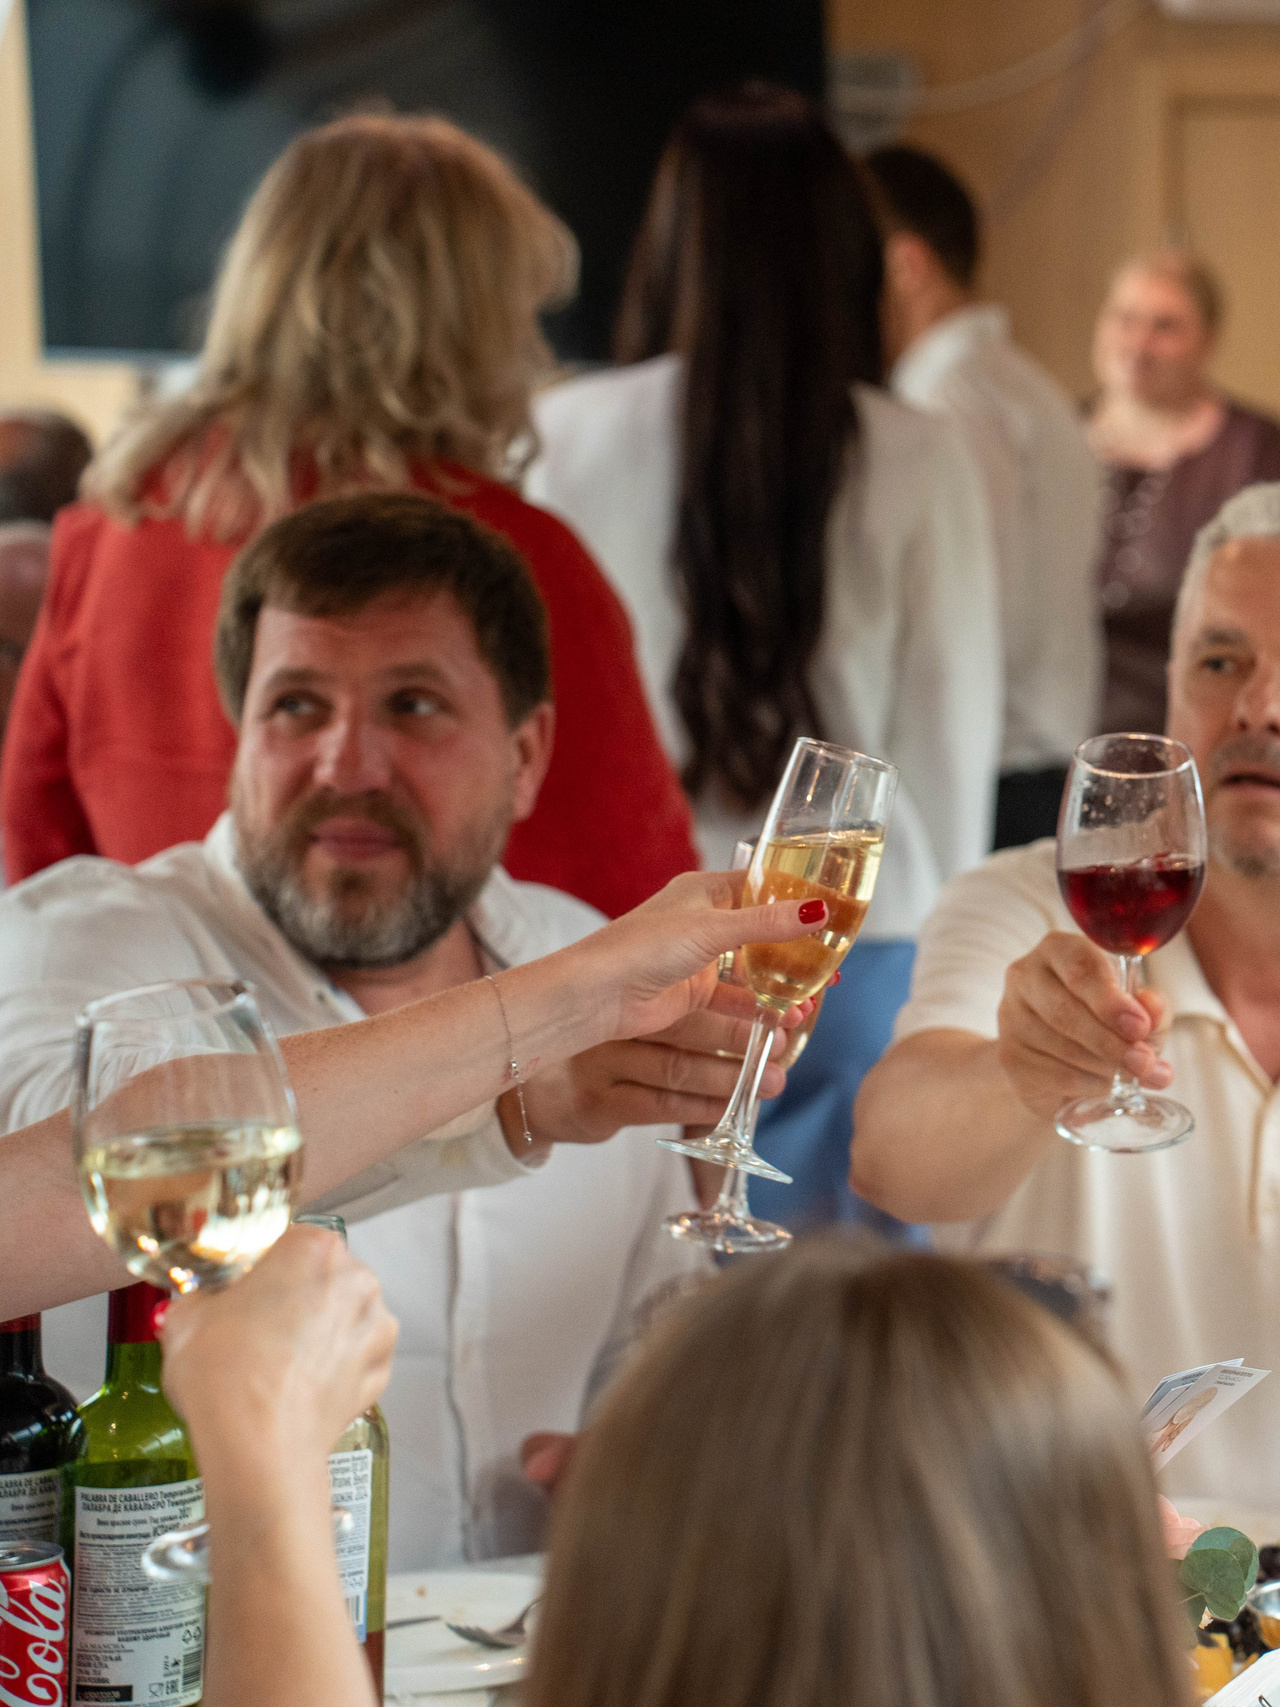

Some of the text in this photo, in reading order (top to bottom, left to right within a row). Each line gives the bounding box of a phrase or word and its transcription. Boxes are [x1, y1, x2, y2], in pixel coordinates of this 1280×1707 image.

[108, 1494, 118, 1503] DE
[119, 1491, 159, 1503] CABALLERO
[112, 1503, 121, 1514] ДЕ
